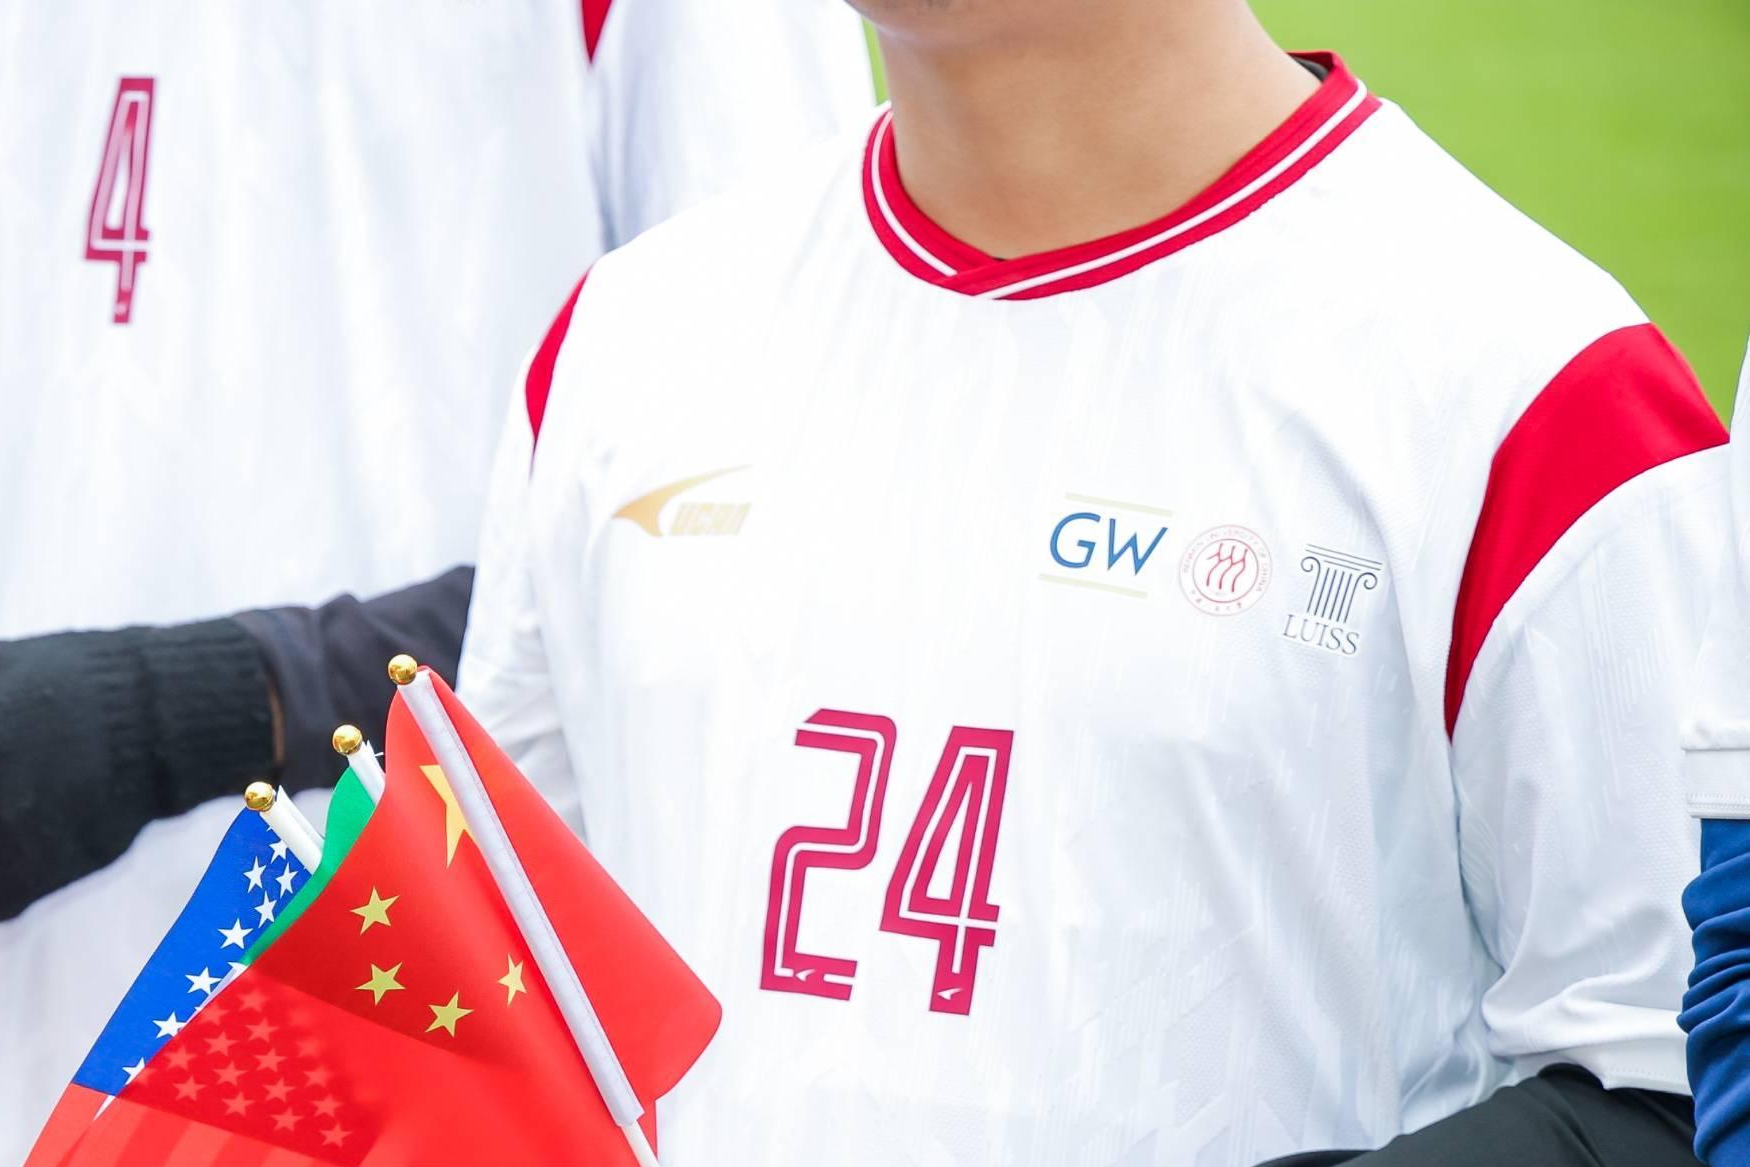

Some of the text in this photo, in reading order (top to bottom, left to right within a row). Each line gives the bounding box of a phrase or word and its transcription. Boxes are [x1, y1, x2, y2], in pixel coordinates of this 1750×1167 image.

[82, 75, 158, 327] 4
[1049, 511, 1169, 577] GW
[1282, 613, 1361, 656] LUISS
[758, 707, 1016, 1017] 24
